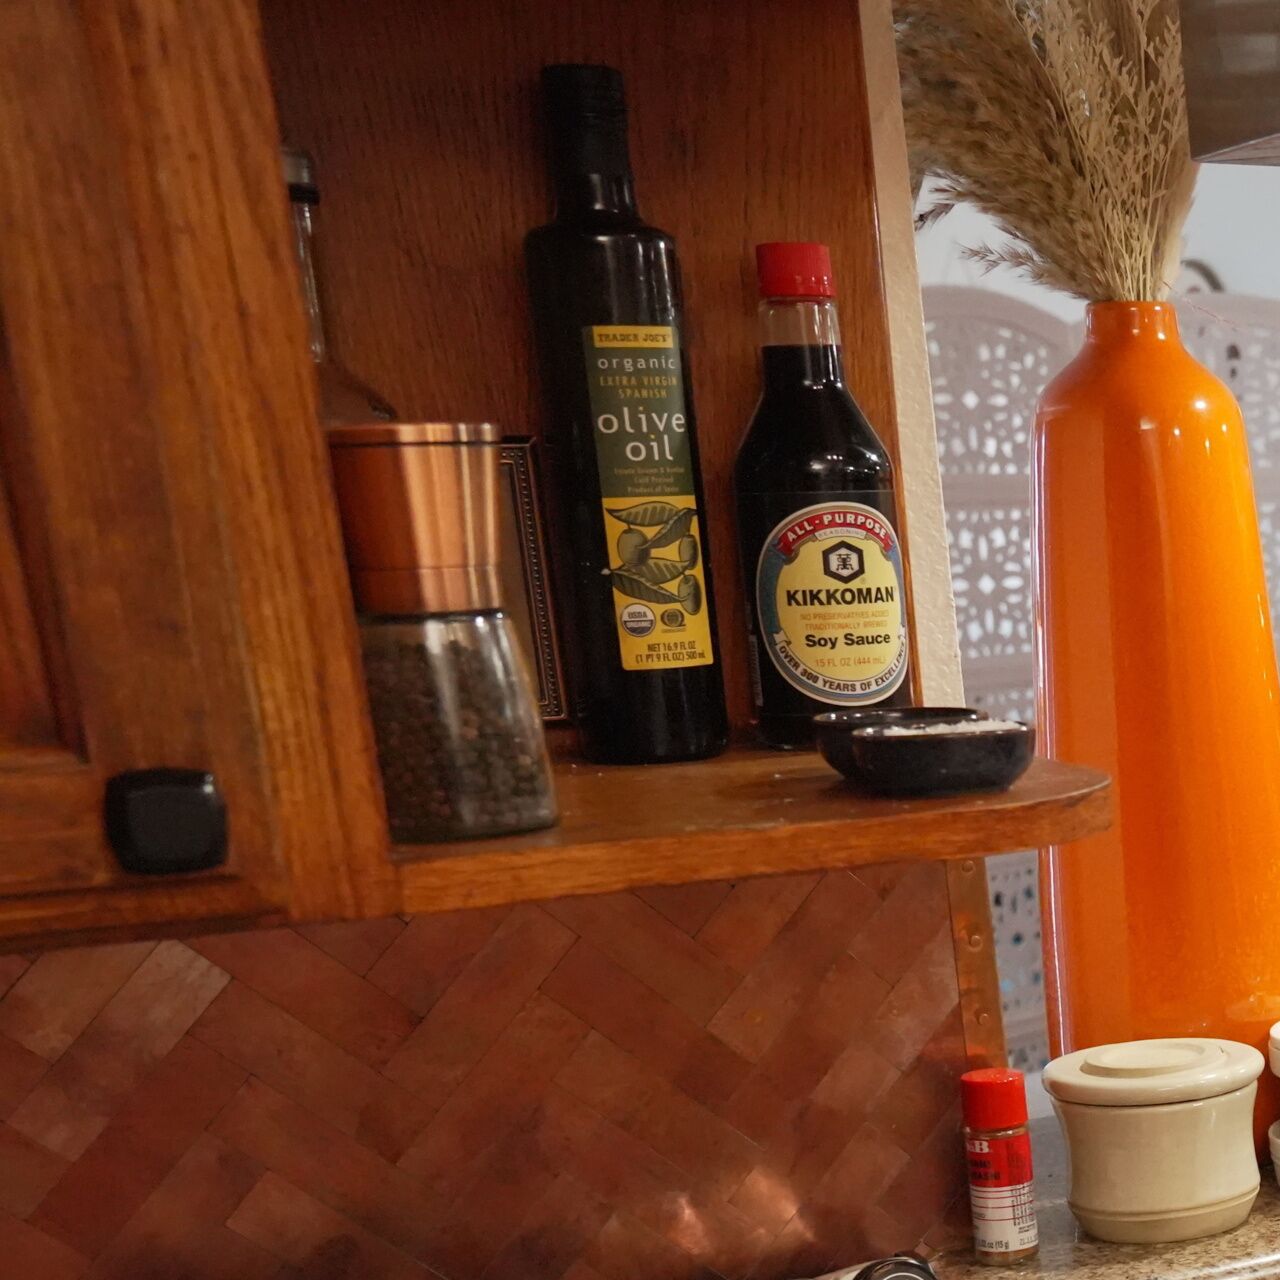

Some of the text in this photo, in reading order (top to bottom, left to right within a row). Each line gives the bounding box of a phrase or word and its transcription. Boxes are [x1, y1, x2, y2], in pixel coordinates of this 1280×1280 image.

[598, 356, 676, 372] organic
[600, 375, 637, 387] EXTRA
[619, 388, 668, 399] SPANISH
[598, 406, 685, 434] olive
[626, 434, 674, 461] oil
[787, 513, 888, 542] ALL-PURPOSE
[786, 587, 894, 607] KIKKOMAN
[628, 611, 648, 620] USDA
[648, 643, 661, 652] NET
[663, 642, 678, 651] 16.9
[805, 633, 891, 649] Soy Sauce
[779, 645, 800, 670] OVER
[801, 668, 819, 684] 300
[822, 680, 857, 692] YEARS
[860, 680, 872, 691] OF
[816, 658, 825, 667] 15
[827, 658, 837, 667] FL
[840, 658, 850, 667] OZ
